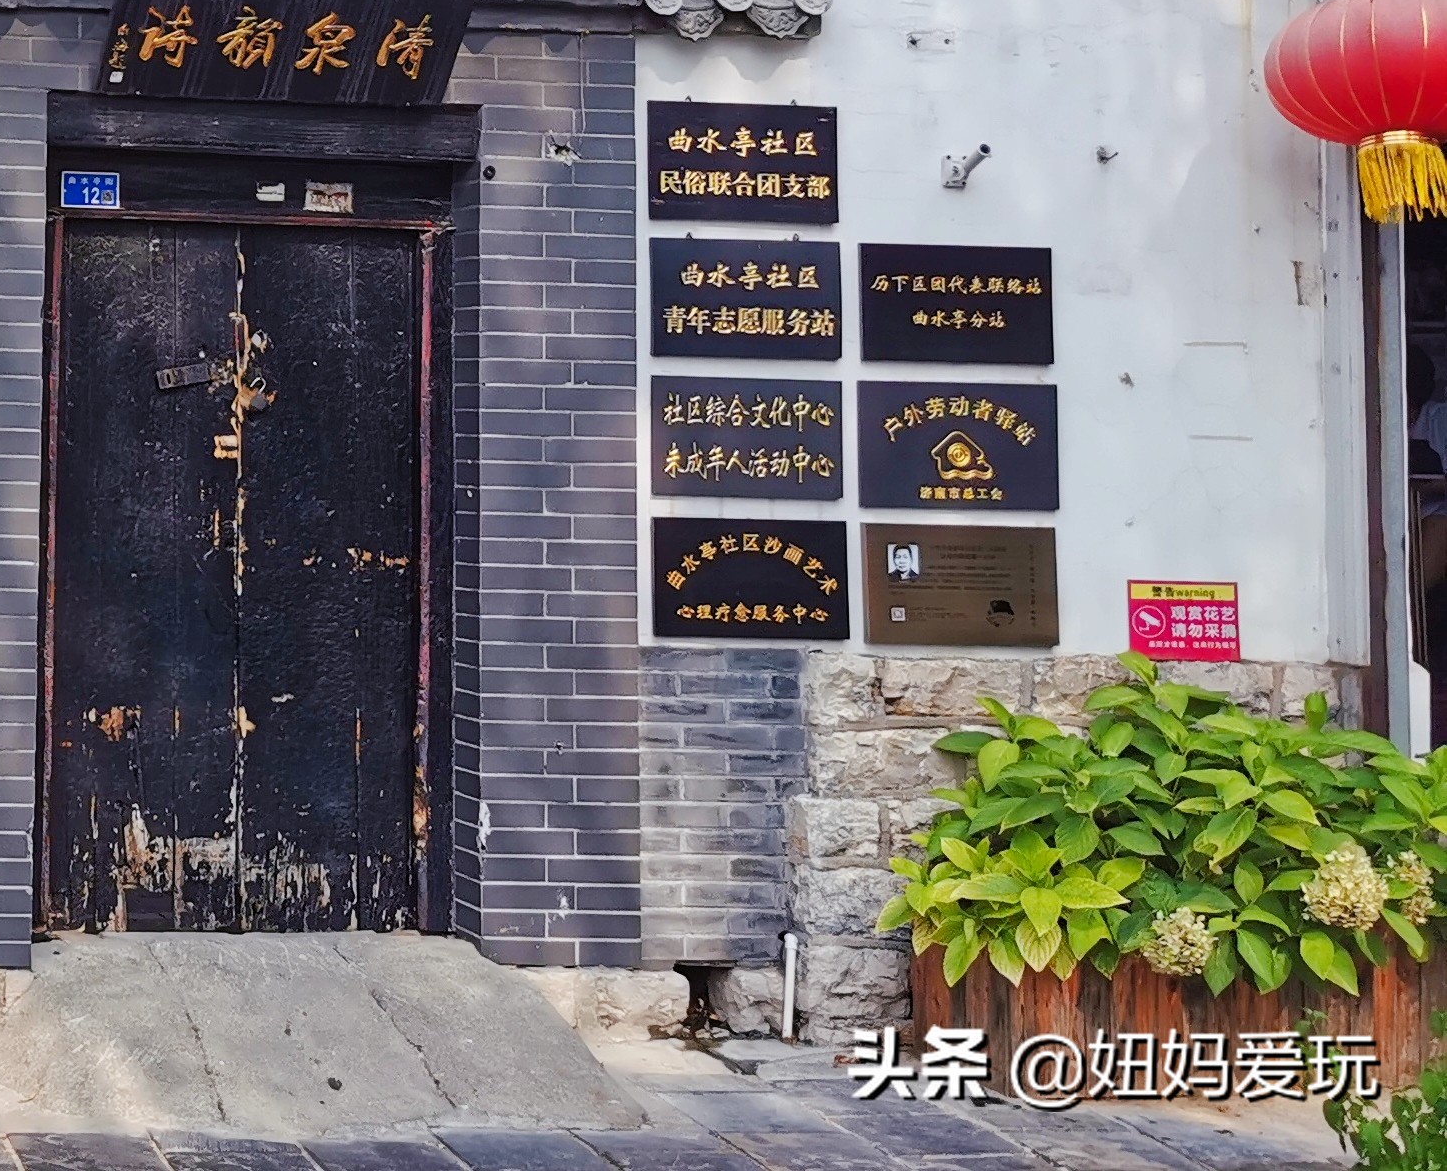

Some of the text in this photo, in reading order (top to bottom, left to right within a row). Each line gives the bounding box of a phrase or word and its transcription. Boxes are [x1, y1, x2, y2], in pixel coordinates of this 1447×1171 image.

[668, 127, 818, 158] 曲水亭社区
[82, 187, 100, 204] 12
[660, 170, 831, 200] 民俗联合团支部
[680, 260, 821, 291] 曲水亭社区
[870, 274, 1043, 296] 历下区团代表联络站
[662, 305, 835, 338] 青年志愿服务站
[911, 308, 1006, 331] 曲水亭分站
[663, 392, 835, 432] 社区综合文化中心
[883, 395, 1037, 447] 户外劳动者驿站
[663, 441, 835, 484] 未成年人活动中心
[919, 486, 1003, 501] 济南市总工会
[665, 533, 839, 596] 曲水亭社区沙画艺术
[676, 601, 830, 625] 心理疗愈服务中心
